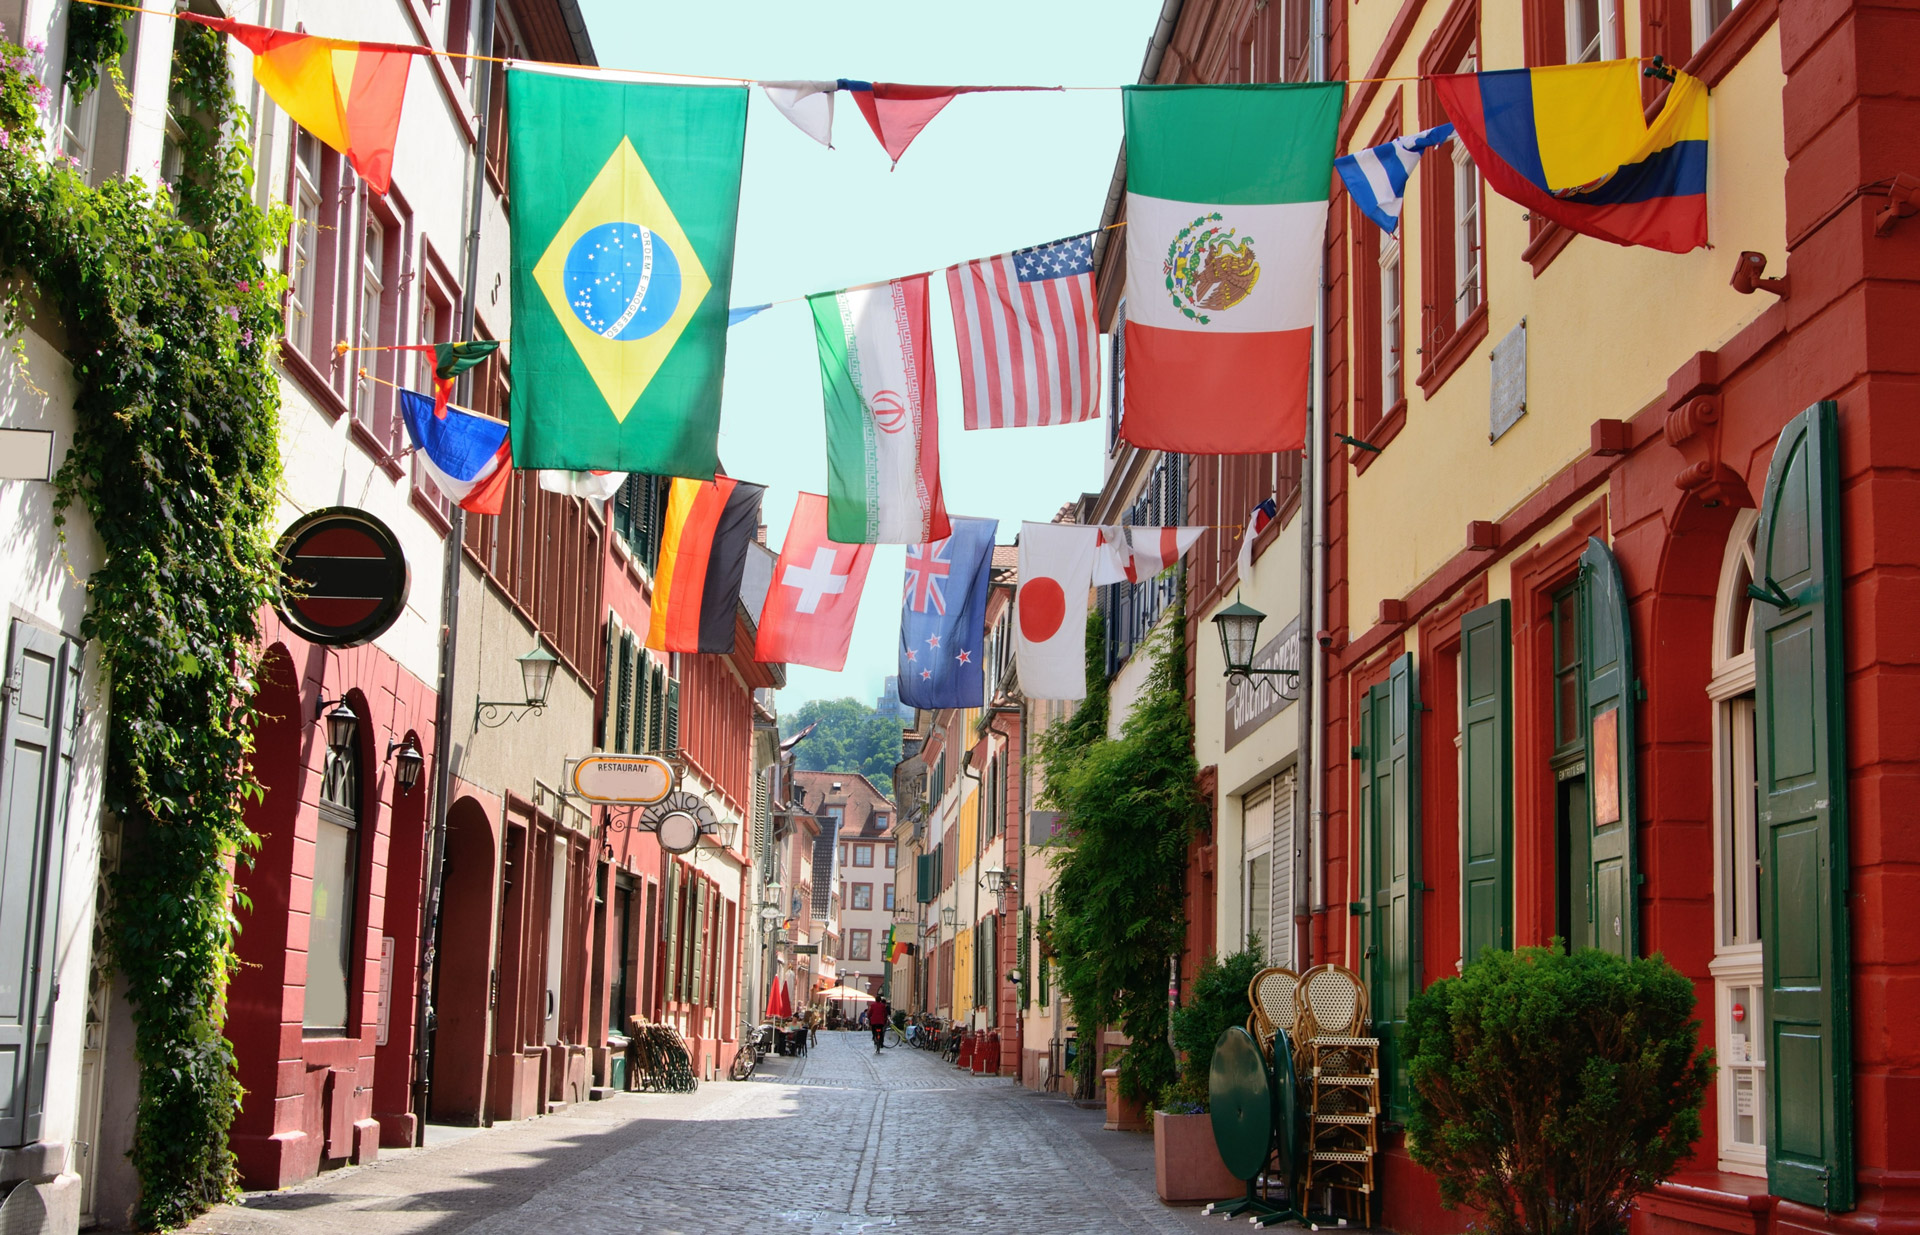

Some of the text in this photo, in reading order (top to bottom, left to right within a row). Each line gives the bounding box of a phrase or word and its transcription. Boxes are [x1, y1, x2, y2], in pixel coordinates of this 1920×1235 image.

[642, 231, 652, 270] ORDEM
[606, 286, 646, 338] PROGRESSO
[597, 763, 649, 773] RESTAURANT
